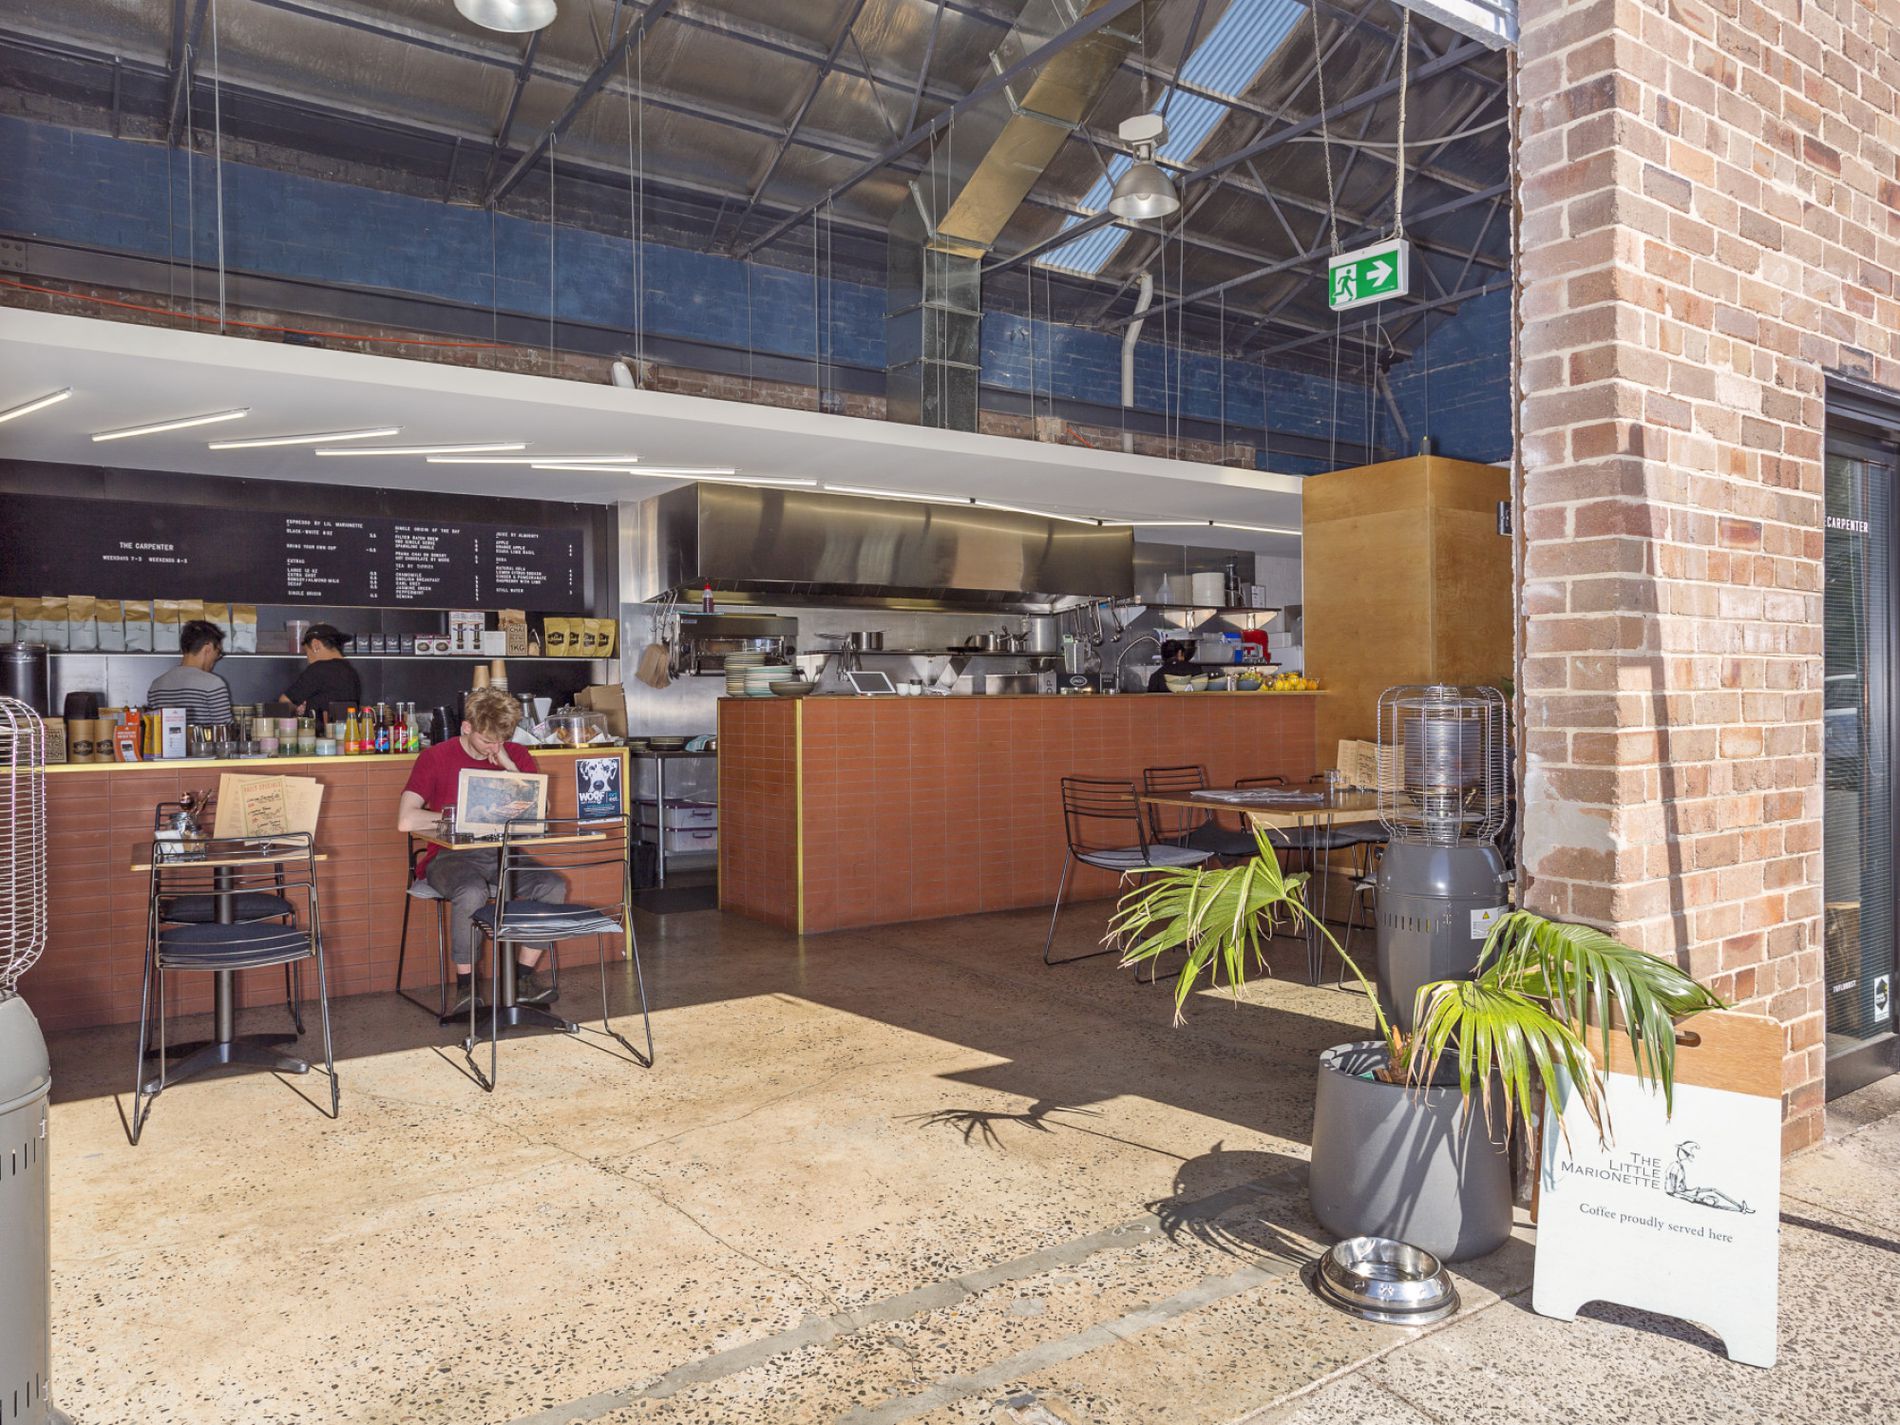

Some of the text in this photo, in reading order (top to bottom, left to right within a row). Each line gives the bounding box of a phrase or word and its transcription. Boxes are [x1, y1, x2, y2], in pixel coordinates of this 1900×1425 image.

[1826, 516, 1868, 532] CARPENTER
[135, 543, 174, 551] CARPENTER
[579, 790, 605, 803] WOOF
[1630, 1152, 1662, 1168] THE
[1561, 1160, 1660, 1190] MARIONETTE
[1609, 1160, 1661, 1178] LITTLE
[1579, 1202, 1733, 1243] Coffee proudly served here
